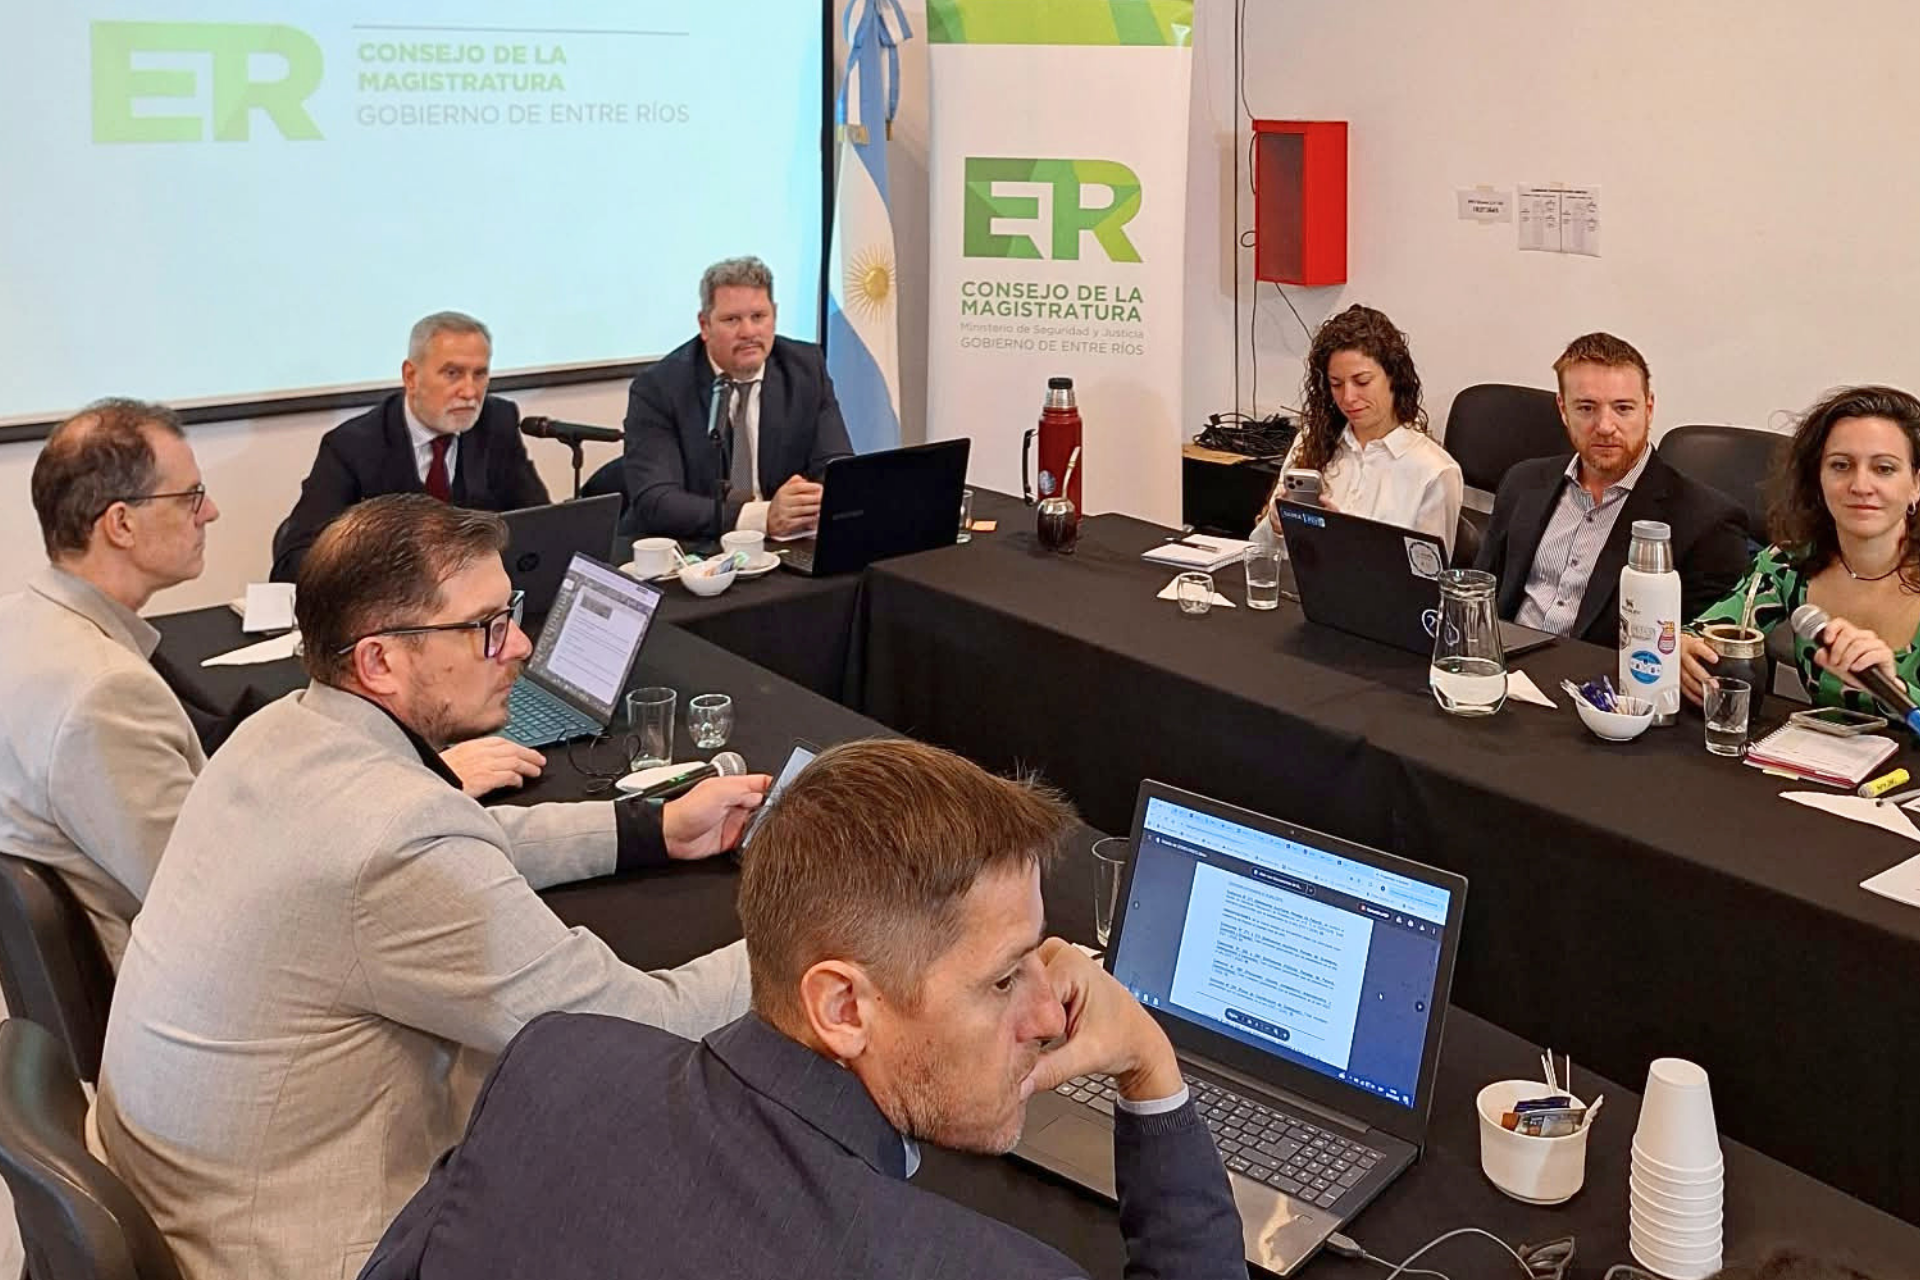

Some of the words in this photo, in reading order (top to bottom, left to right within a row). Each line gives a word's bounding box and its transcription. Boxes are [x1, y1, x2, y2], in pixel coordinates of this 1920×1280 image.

[358, 42, 486, 65] CONSEJO
[494, 44, 528, 65] DE
[535, 45, 567, 66] LA
[91, 20, 327, 144] ER
[358, 70, 567, 92] MAGISTRATURA
[357, 103, 501, 126] GOBIERNO
[509, 103, 543, 125] DE
[551, 102, 629, 124] ENTRE
[637, 99, 690, 124] RÍOS
[964, 157, 1143, 263] ER
[961, 281, 1070, 300] CONSEJO
[1078, 284, 1108, 302] DE
[1115, 286, 1144, 304] LA
[961, 299, 1142, 322] MAGISTRATURA
[960, 322, 1014, 334] Ministerio
[1016, 324, 1030, 334] de
[1033, 324, 1090, 338] Seguridad
[1092, 328, 1099, 338] y
[1101, 326, 1145, 339] Justicia
[960, 336, 1035, 351] GOBIERNO
[1038, 339, 1058, 352] DE
[1061, 340, 1108, 354] ENTRE
[1111, 341, 1145, 356] RÍOS
